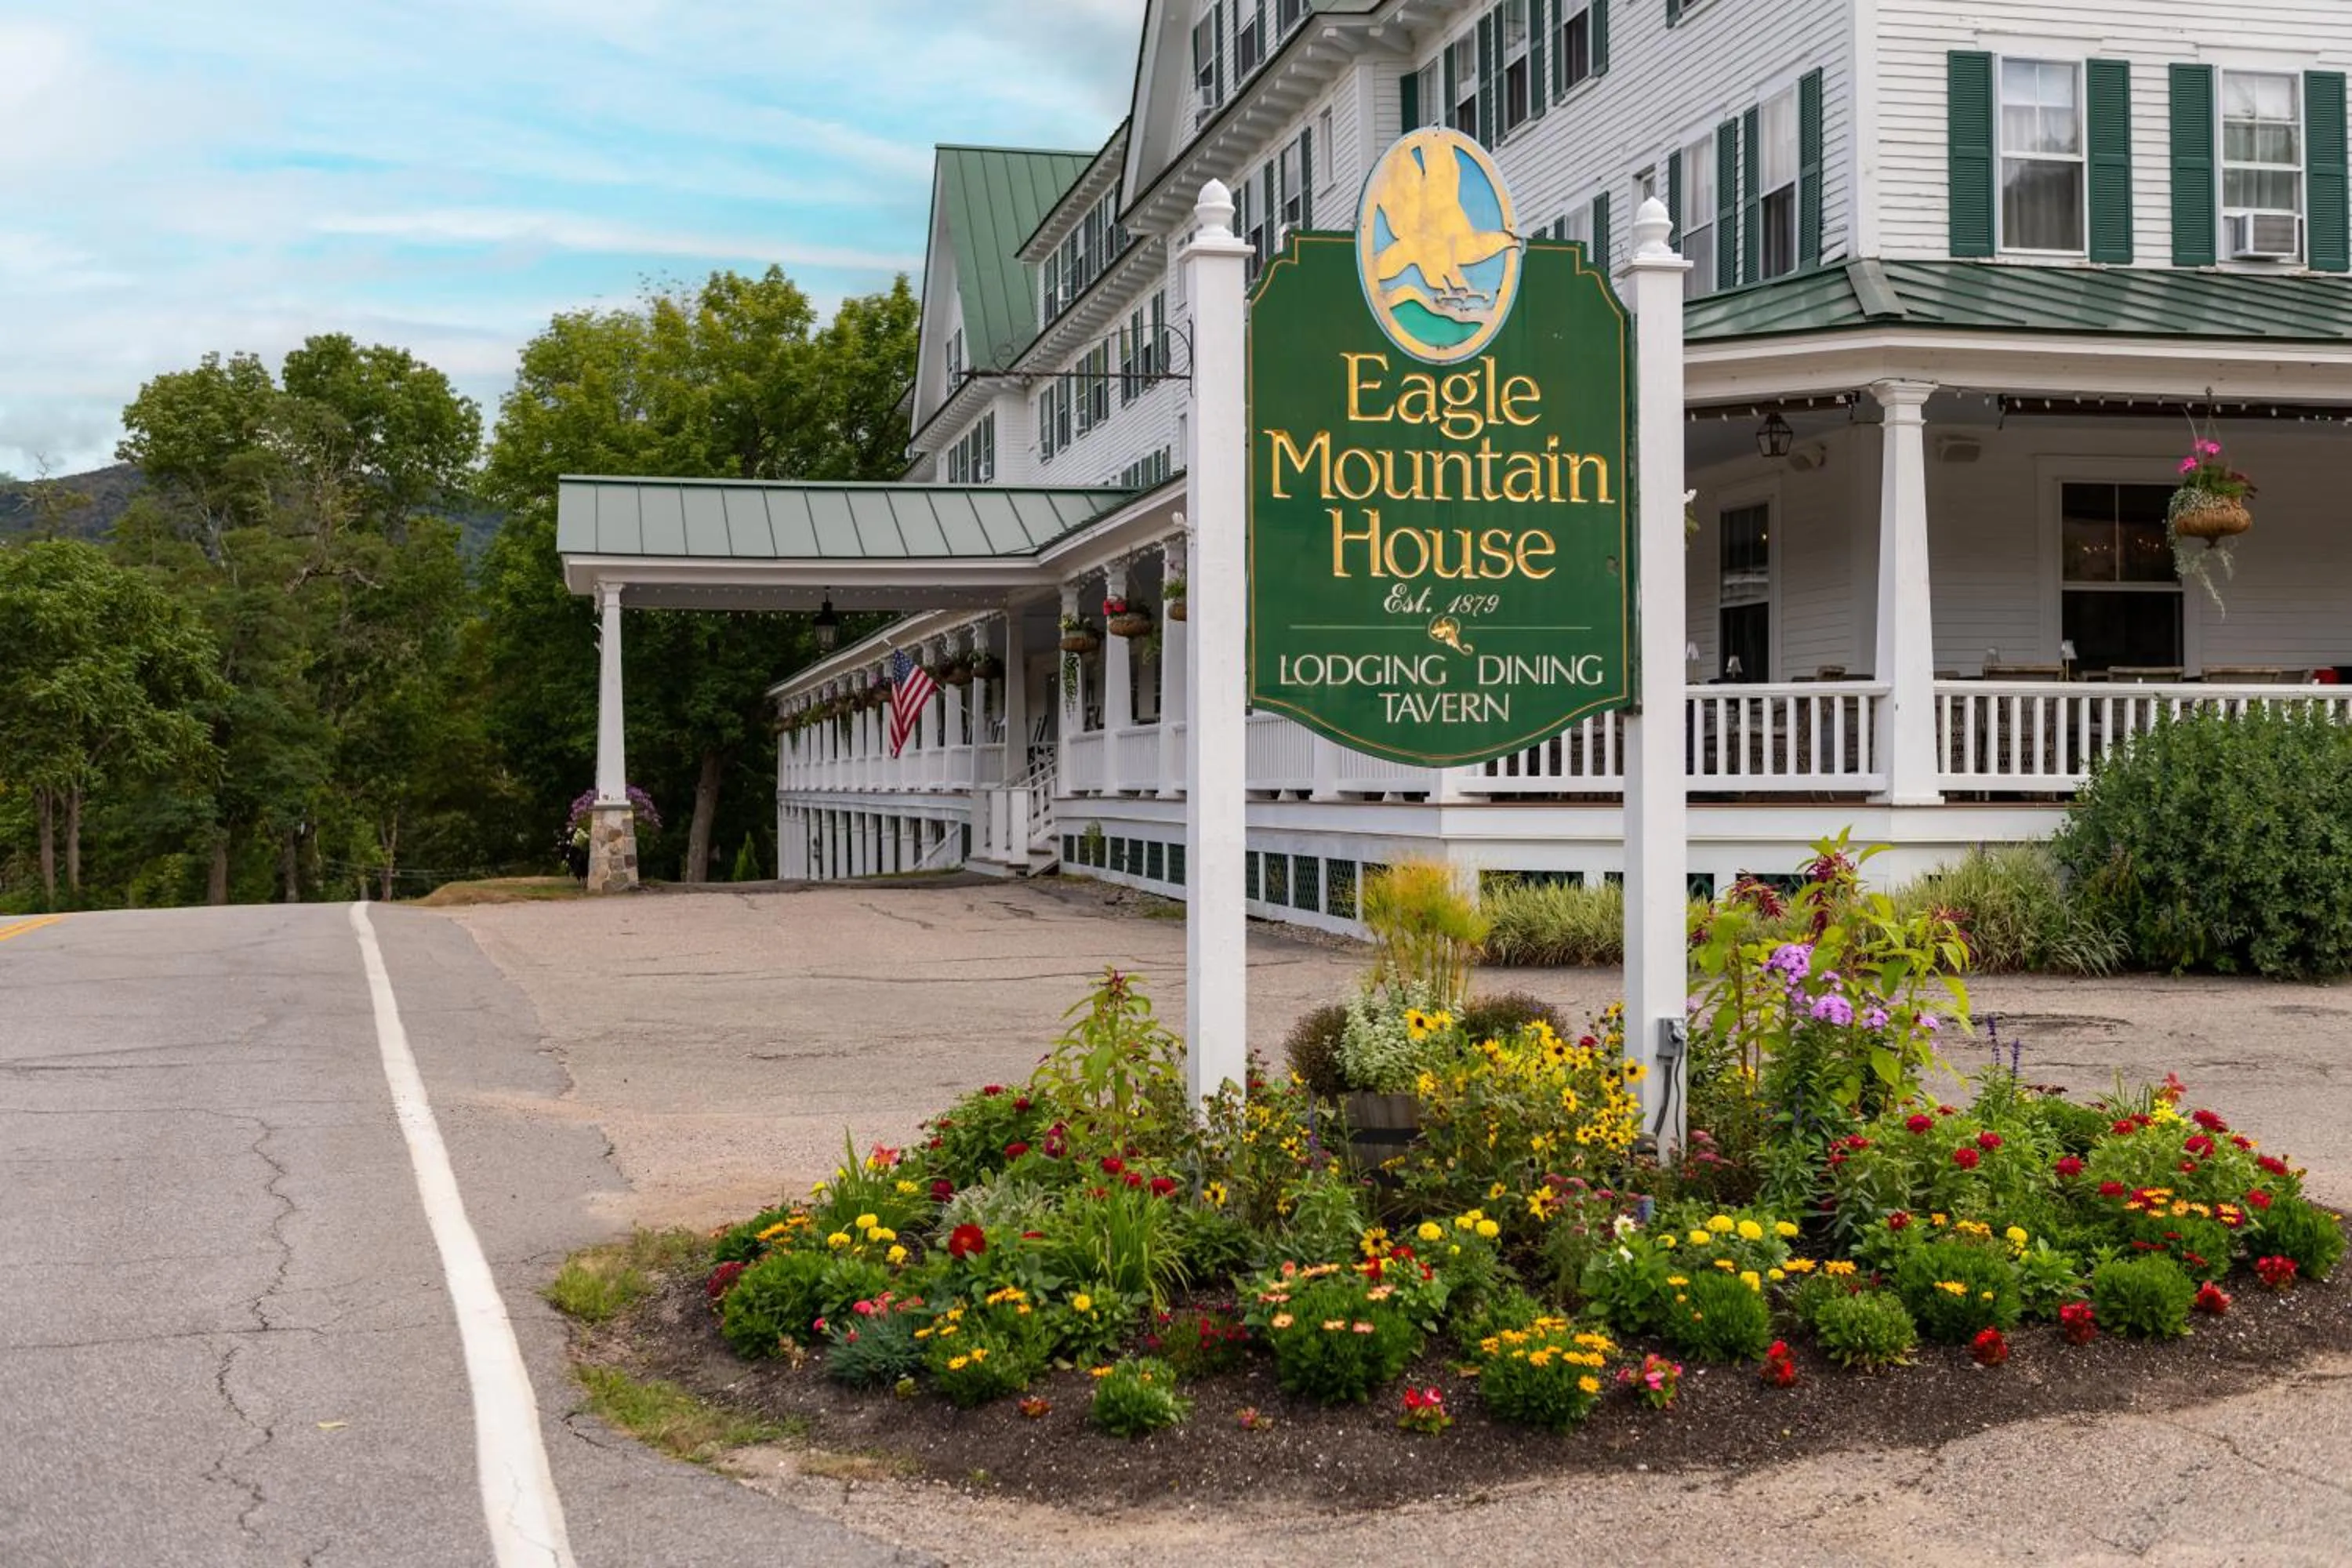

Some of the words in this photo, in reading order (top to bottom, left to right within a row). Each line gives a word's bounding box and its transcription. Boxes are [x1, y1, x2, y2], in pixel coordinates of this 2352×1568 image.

[1340, 352, 1541, 441] Eagle
[1263, 429, 1616, 504] Mountain
[1325, 507, 1557, 580] House
[1383, 583, 1432, 615] Est.
[1448, 593, 1500, 616] 1879
[1279, 654, 1447, 686] LODGING
[1477, 654, 1604, 686] DINING
[1377, 692, 1510, 724] TAVERN
